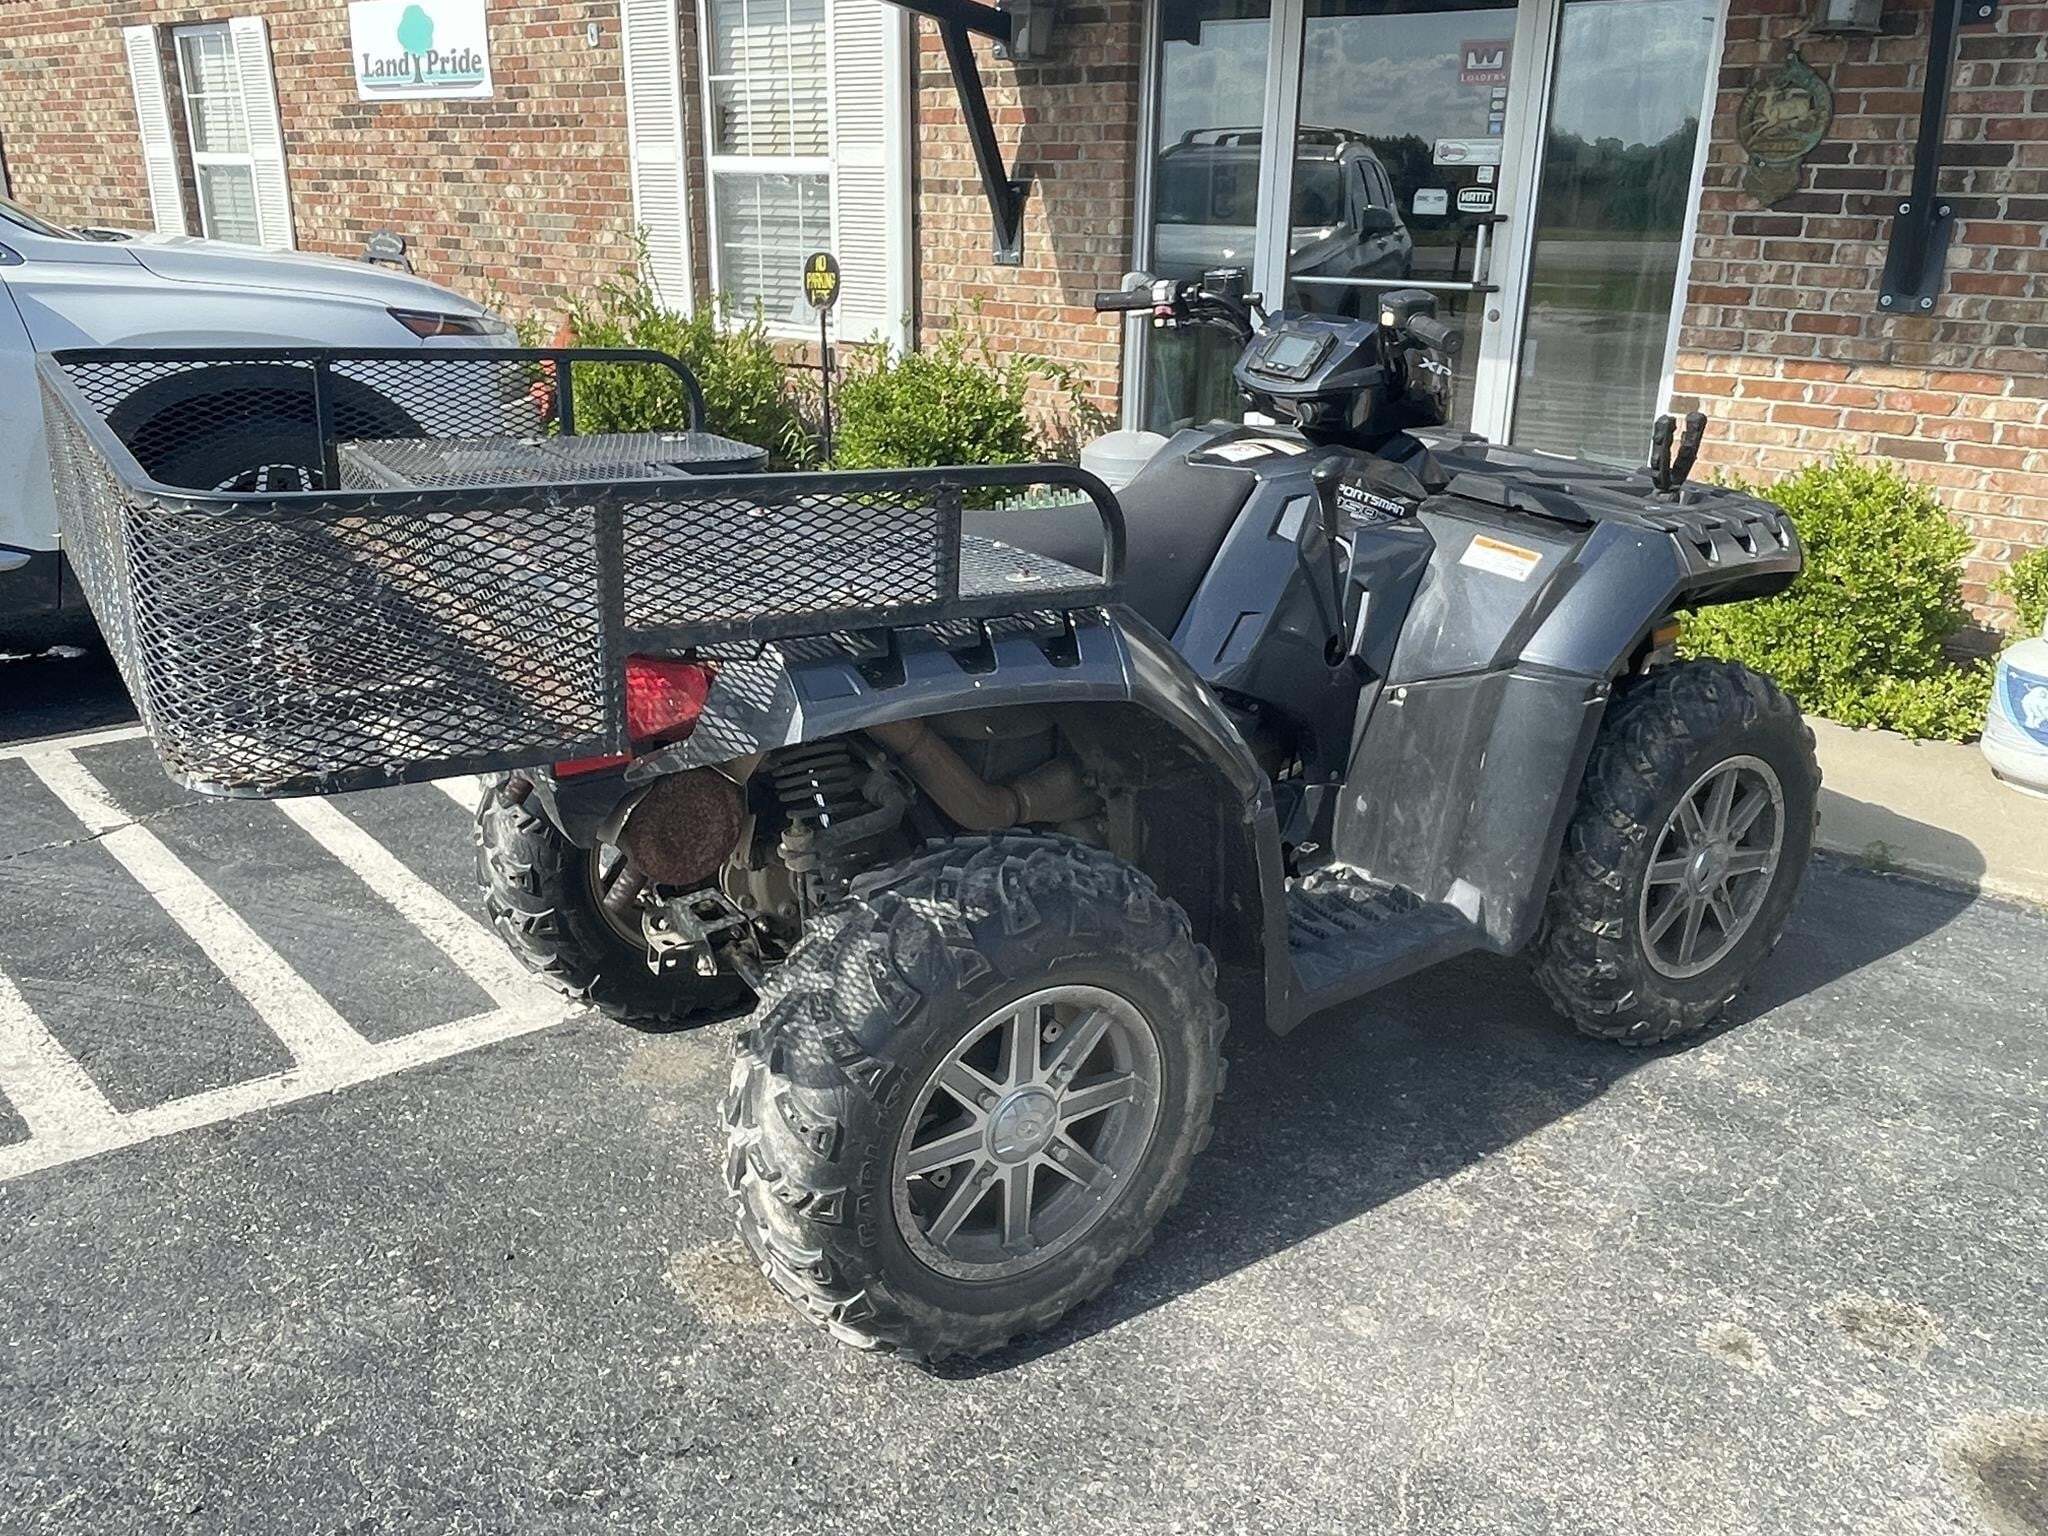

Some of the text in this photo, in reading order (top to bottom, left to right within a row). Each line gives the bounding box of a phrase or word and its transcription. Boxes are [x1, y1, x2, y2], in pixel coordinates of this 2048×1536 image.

[362, 47, 482, 77] Land Pride
[1418, 357, 1452, 376] XP
[1338, 483, 1405, 516] PORTSMAN
